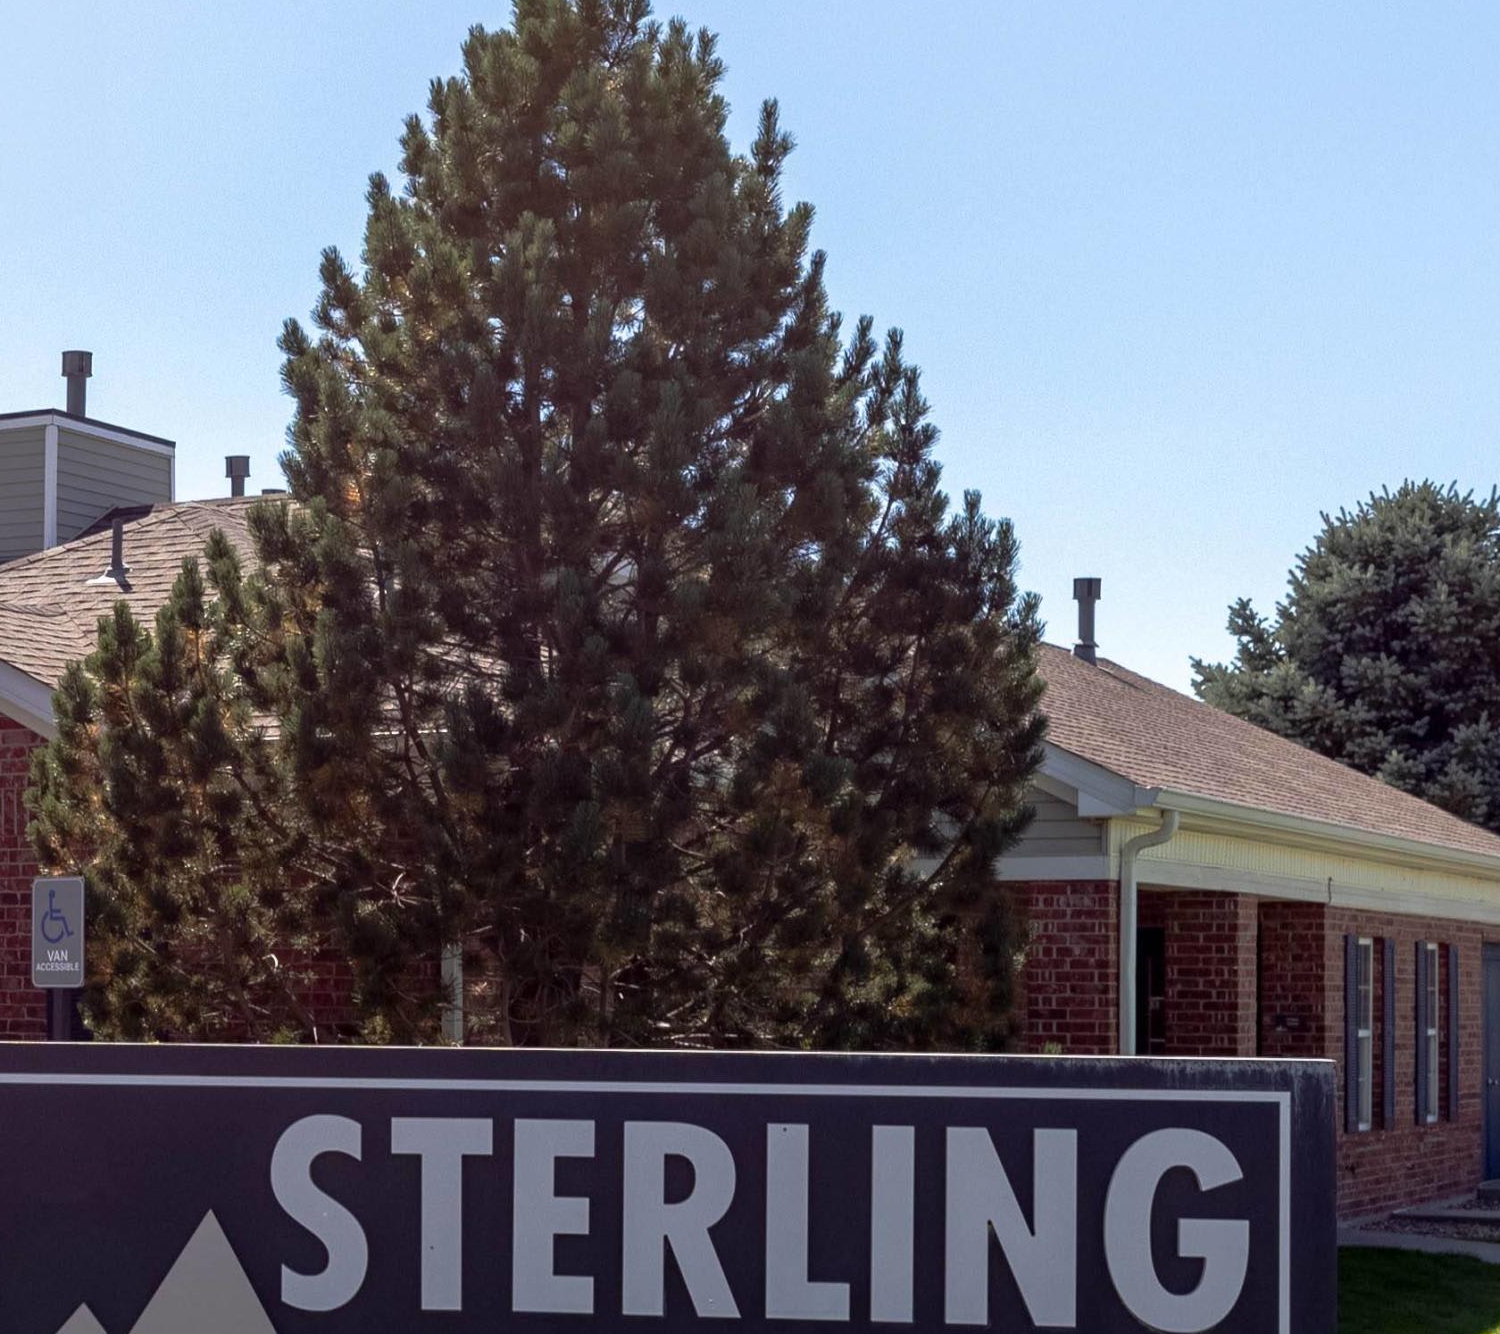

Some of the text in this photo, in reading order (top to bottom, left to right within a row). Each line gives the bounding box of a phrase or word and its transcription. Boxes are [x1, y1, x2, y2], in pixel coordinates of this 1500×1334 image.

[47, 949, 68, 962] VAN
[36, 961, 80, 972] ACCESSIBLE
[271, 1114, 1250, 1334] STERLING
